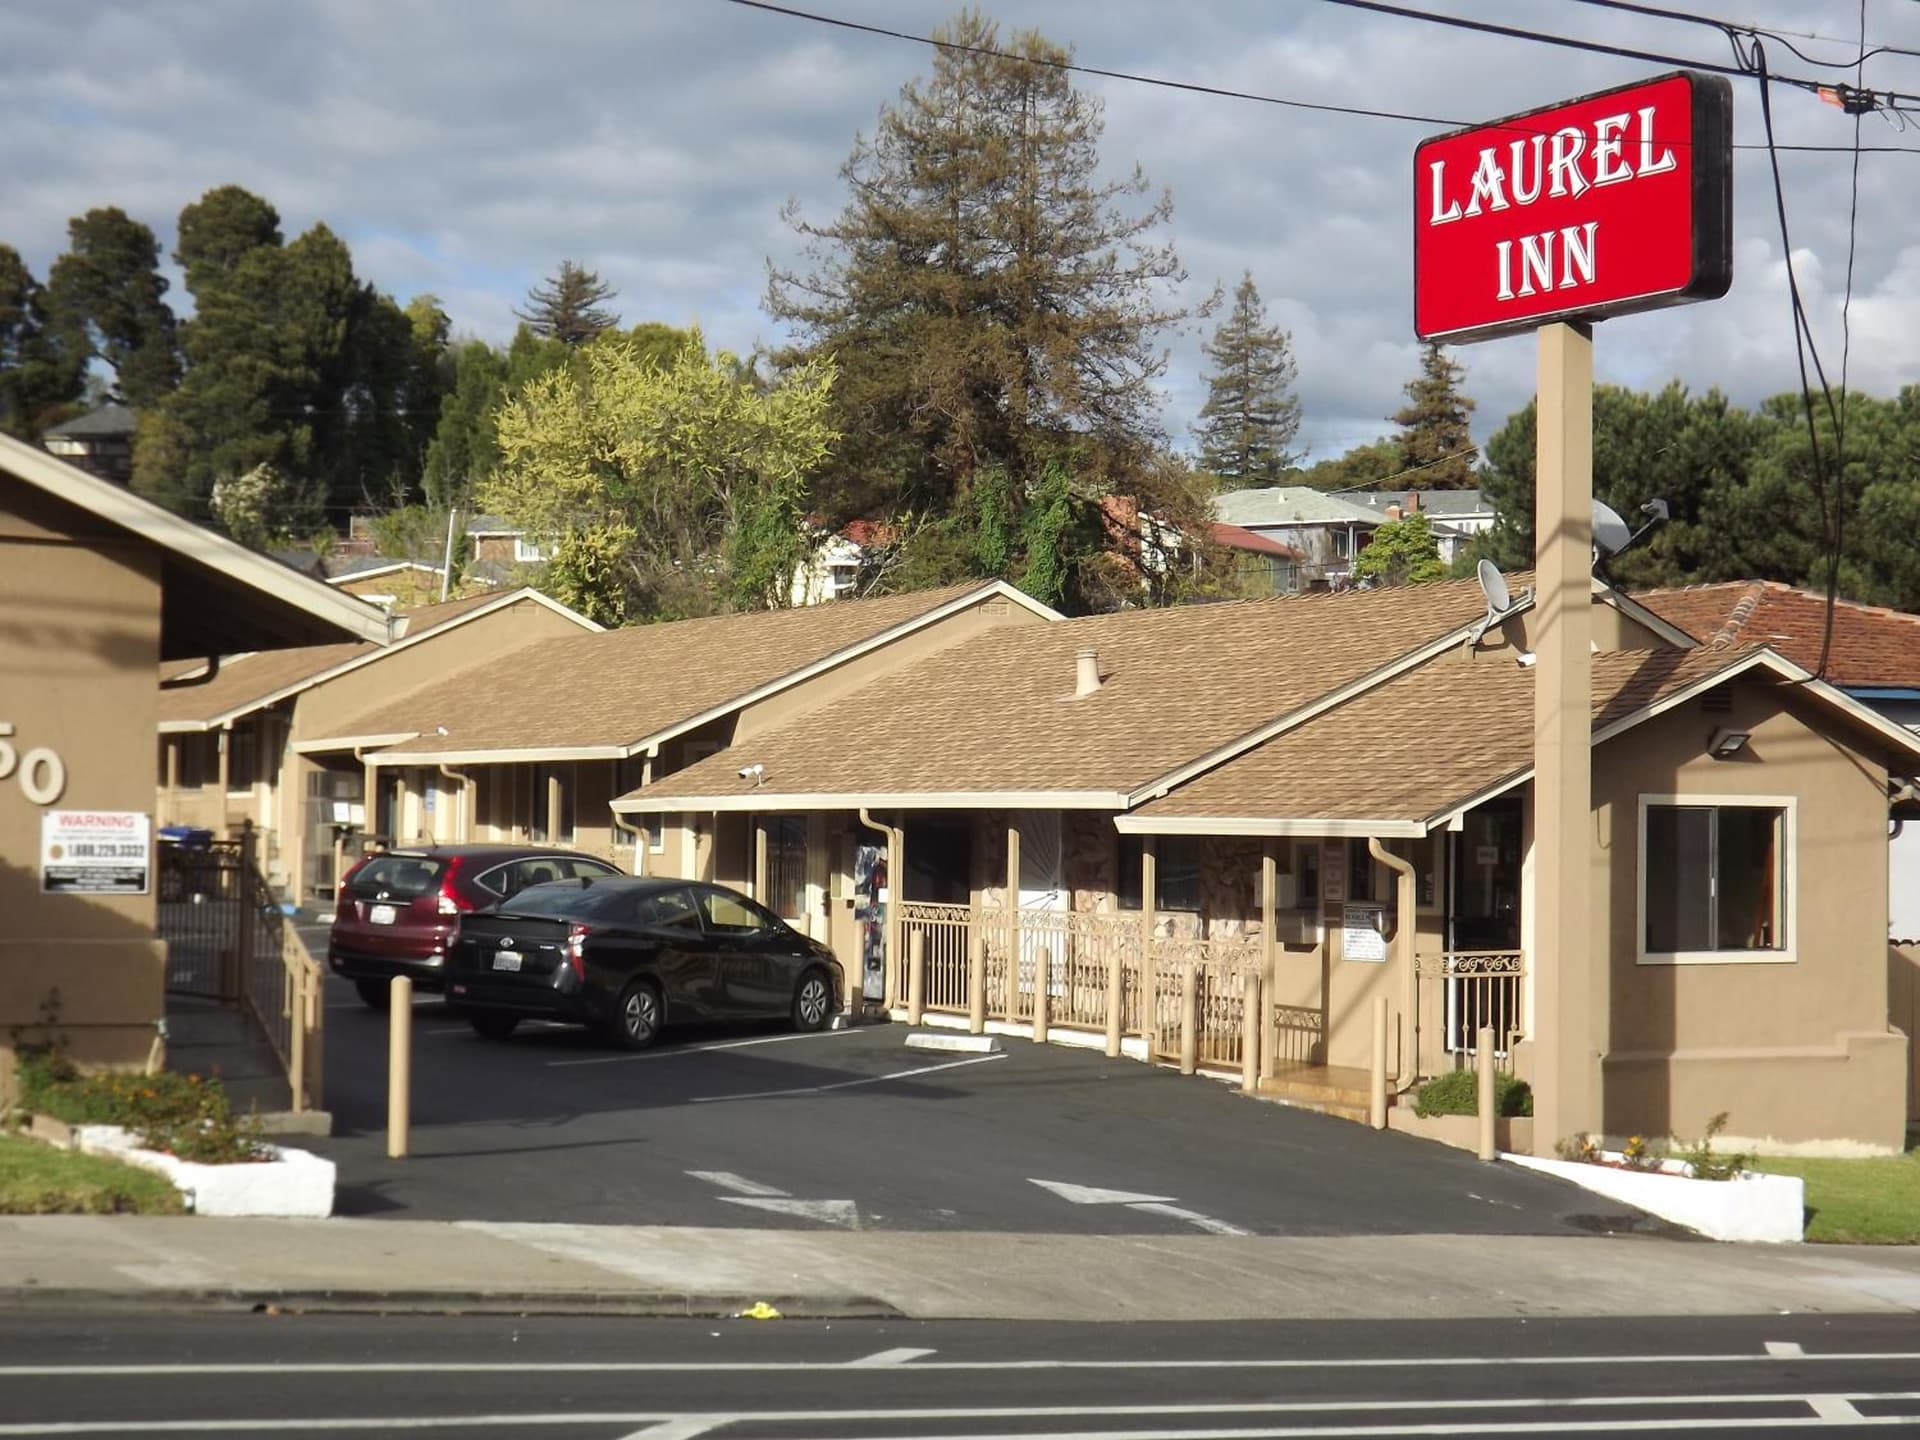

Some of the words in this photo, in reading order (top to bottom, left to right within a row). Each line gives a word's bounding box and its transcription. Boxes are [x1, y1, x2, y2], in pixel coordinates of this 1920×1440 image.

[1430, 106, 1677, 226] LAUREL
[1495, 222, 1599, 301] INN
[59, 815, 135, 828] WARNING
